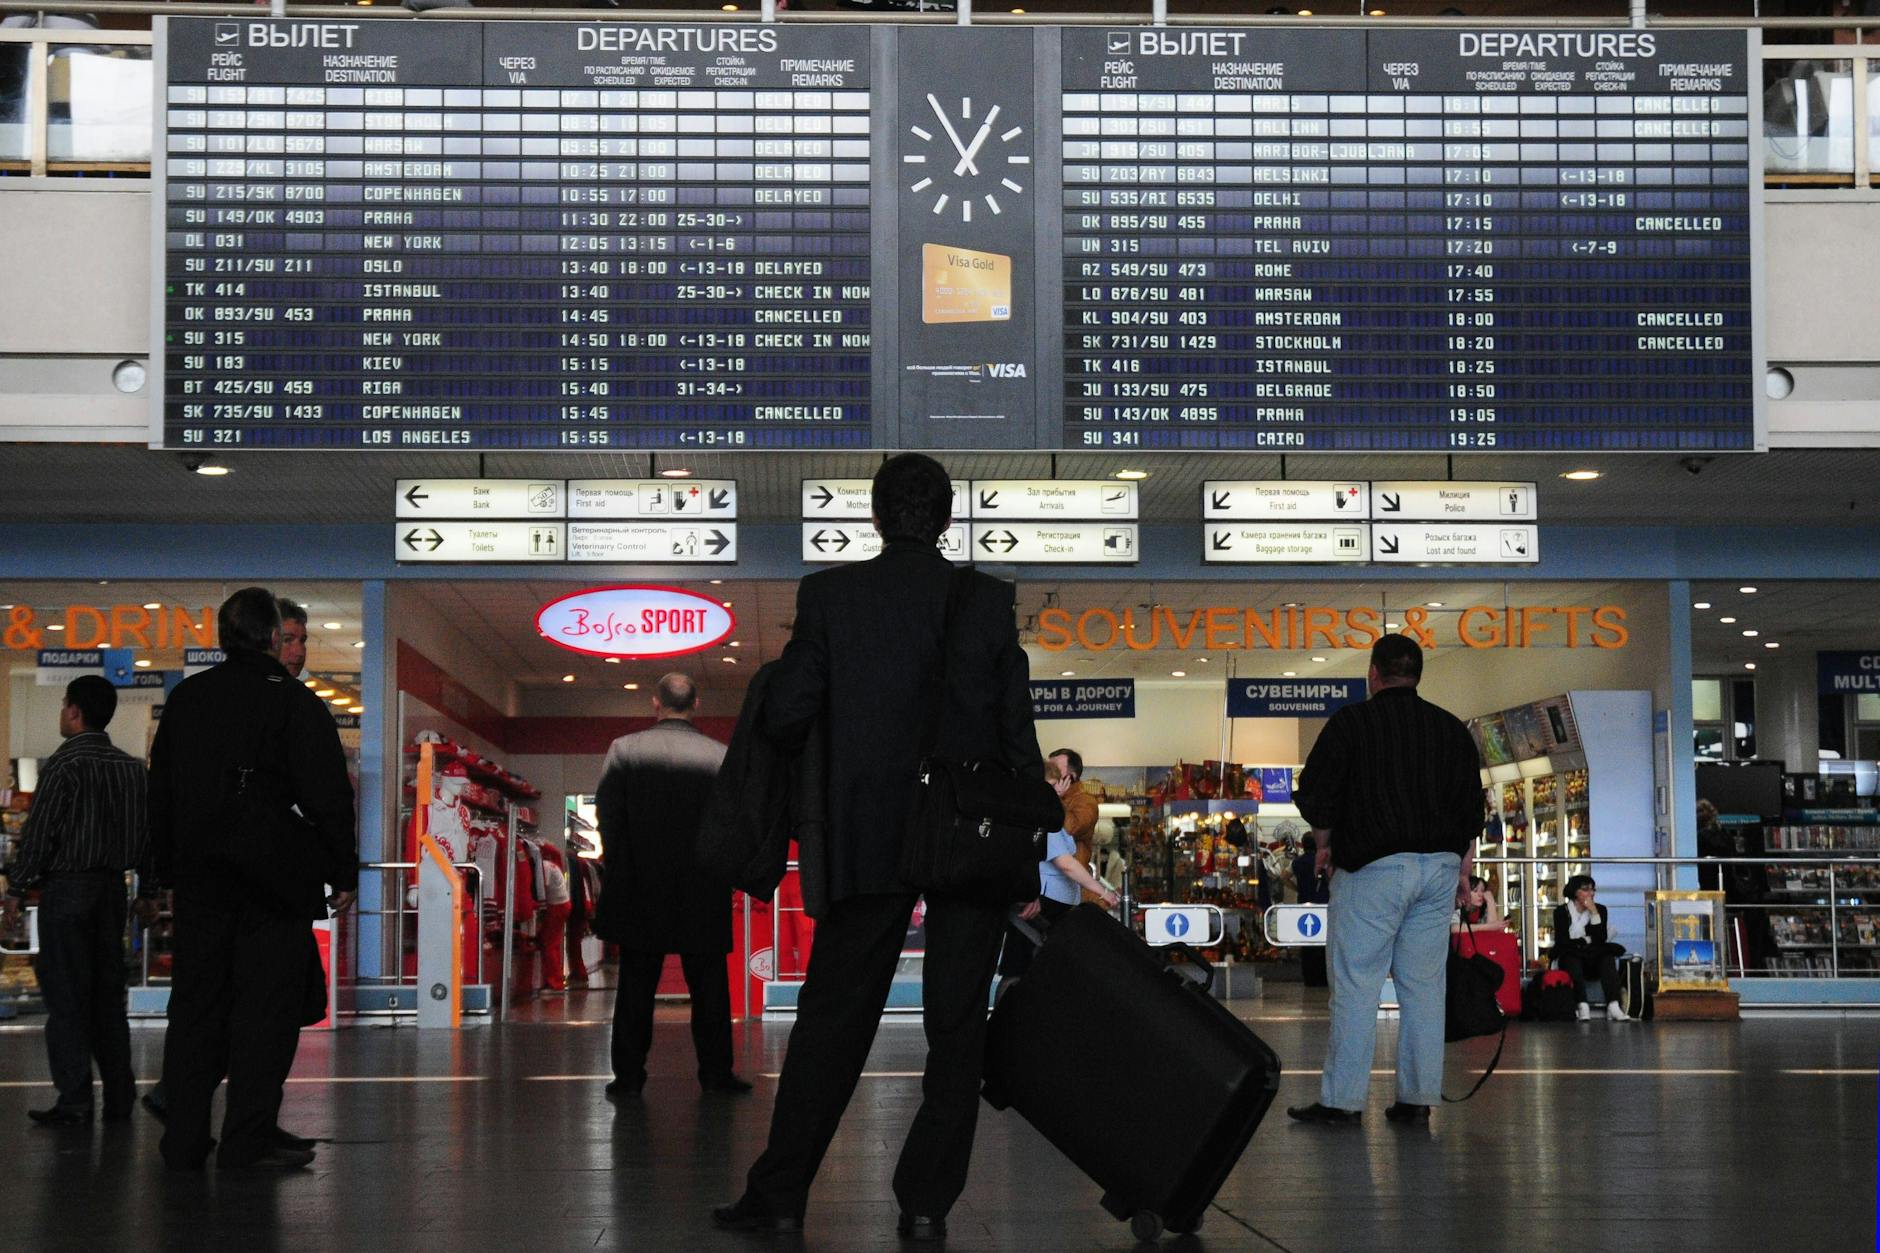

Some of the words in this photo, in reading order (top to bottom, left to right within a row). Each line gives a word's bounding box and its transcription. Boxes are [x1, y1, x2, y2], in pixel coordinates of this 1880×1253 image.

[249, 25, 358, 48] ВЫЛЕТ
[577, 28, 778, 52] DEPARTURES
[1140, 32, 1246, 55] ВЫЛЕТ
[1459, 33, 1657, 58] DEPARTURES
[211, 51, 243, 67] РЕЙС
[323, 55, 398, 68] НАЗНАЧЕНИЕ
[499, 57, 536, 70] ЧЕРЕЗ
[716, 56, 745, 66] СТОЙКА
[706, 67, 755, 76] РЕГИСТРАЦИИ
[780, 60, 855, 73] ПРИМЕЧАНИЕ
[1104, 60, 1136, 74] РЕЙС
[1212, 62, 1283, 75] НАЗНАЧЕНИЕ
[1383, 63, 1419, 76] ЧЕРЕЗ
[1659, 63, 1733, 77] ПРИМЕЧАНИЕ
[207, 68, 246, 81] FLIGHT
[325, 69, 396, 83] DESTINATION
[509, 71, 527, 84] VIA
[791, 73, 844, 86] REMARKS
[593, 76, 636, 86] SCHEDULED
[654, 77, 691, 86] EXPECTED
[715, 77, 748, 86] CHECK-IN
[1100, 76, 1138, 88] FLIGHT
[1214, 77, 1282, 90] DESTINATION
[1392, 77, 1410, 91] VIA
[1670, 78, 1722, 91] REMARKS
[364, 162, 452, 175] AMSTERDAM
[1253, 168, 1329, 181] HELSINKI
[364, 188, 463, 200] COPENHAGEN
[1254, 192, 1301, 205] DELHI
[364, 212, 413, 224] PRAHA
[1254, 216, 1302, 229] PRAHA
[1447, 217, 1492, 230] 17:15
[1636, 217, 1721, 230] CANCELLED
[364, 236, 393, 248] NEW
[403, 236, 443, 248] YORK
[1255, 240, 1281, 252] TEL
[1293, 241, 1329, 253] AVIV
[1448, 241, 1492, 253] 17:20
[364, 260, 402, 272] OSLO
[563, 262, 608, 273] 13:40
[621, 262, 667, 274] 18:00
[755, 262, 822, 274] DELAYED
[948, 255, 969, 268] Visa
[972, 258, 995, 271] Gold
[1255, 264, 1291, 276] ROME
[1448, 265, 1493, 277] 17:40
[186, 283, 204, 295] TK
[216, 284, 244, 295] 414
[364, 284, 440, 297] ISTANBUL
[563, 286, 608, 298] 13:40
[755, 286, 802, 298] CHECK
[813, 286, 831, 298] IN
[842, 286, 870, 299] NOW
[1256, 288, 1311, 300] WARSAW
[1449, 289, 1493, 301] 17:55
[364, 309, 411, 321] PRAHA
[563, 310, 608, 322] 14:45
[755, 310, 841, 322] CANCELLED
[993, 307, 1008, 316] VISA
[1256, 313, 1340, 325] AMSTERDAM
[1449, 313, 1493, 325] 18:00
[1638, 313, 1722, 326] CANCELLED
[363, 333, 392, 345] NEW
[403, 333, 440, 345] YORK
[562, 334, 608, 346] 14:50
[621, 334, 667, 346] 18:00
[755, 335, 802, 346] CHECK
[814, 335, 831, 347] IN
[842, 335, 870, 347] NOW
[1256, 336, 1341, 349] STOCKHOLM
[1449, 337, 1494, 349] 18:20
[1638, 337, 1723, 349] CANCELLED
[363, 357, 401, 369] KIEV
[562, 358, 608, 370] 15:15
[1257, 360, 1331, 373] ISTANBUL
[1450, 361, 1494, 373] 18:25
[986, 363, 1027, 378] VISA
[363, 382, 401, 394] RIGA
[562, 383, 608, 395] 15:40
[1257, 384, 1331, 397] BELGRADE
[1450, 385, 1494, 397] 18:50
[363, 406, 460, 419] COPENHAGEN
[562, 407, 608, 419] 15:45
[755, 407, 842, 419] CANCELLED
[1257, 408, 1303, 421] PRAHA
[1451, 409, 1495, 421] 19:05
[363, 431, 391, 443] LOS
[403, 431, 470, 443] ANGELES
[562, 431, 608, 444] 15:55
[1257, 433, 1304, 445] CAIRO
[1451, 433, 1495, 445] 19:25
[473, 487, 490, 496] Банк
[576, 488, 602, 498] Первая
[605, 489, 634, 498] помощь
[837, 487, 866, 496] Комната
[1027, 488, 1041, 497] Зал
[1042, 488, 1076, 498] прибытия
[1255, 488, 1280, 498] Первая
[1283, 488, 1310, 497] помощь
[1439, 491, 1471, 500] Милиция
[473, 500, 490, 509] Bank
[576, 500, 592, 508] First
[595, 500, 606, 508] aid
[846, 500, 871, 509] Mother
[1039, 502, 1065, 510] Arrivals
[1270, 502, 1285, 510] First
[1287, 502, 1297, 510] aid
[1445, 505, 1466, 513] Police
[469, 529, 498, 540] Туалеты
[856, 529, 879, 539] Тамож
[1036, 531, 1081, 541] Регистрация
[1241, 530, 1267, 541] Камера
[1303, 530, 1328, 540] багажа
[1425, 533, 1450, 543] Розыск
[1452, 533, 1477, 542] багажа
[472, 543, 495, 552] Toilets
[617, 543, 647, 552] Control
[1043, 544, 1074, 553] Check-in
[1256, 544, 1285, 555] Baggage
[1287, 545, 1313, 555] storage
[1426, 546, 1441, 555] Lost
[1443, 546, 1456, 555] and
[1457, 546, 1477, 555] found
[3, 604, 44, 650] &
[64, 604, 214, 650] DRIN
[562, 608, 636, 641] Bosco
[641, 609, 707, 634] SPORT
[1036, 606, 1381, 651] SOUVENIRS
[1399, 605, 1438, 650] &
[1457, 605, 1630, 650] GIFTS
[41, 652, 100, 664] ПОДАРКИ
[1061, 687, 1071, 700] В
[1075, 685, 1132, 702] ДОРОГУ
[1246, 684, 1349, 700] СУВЕНИРЫ
[1043, 703, 1063, 712] FOR
[1066, 703, 1073, 712] A
[1075, 702, 1123, 713] JOURNEY
[1268, 703, 1326, 712] SOUVENIRS
